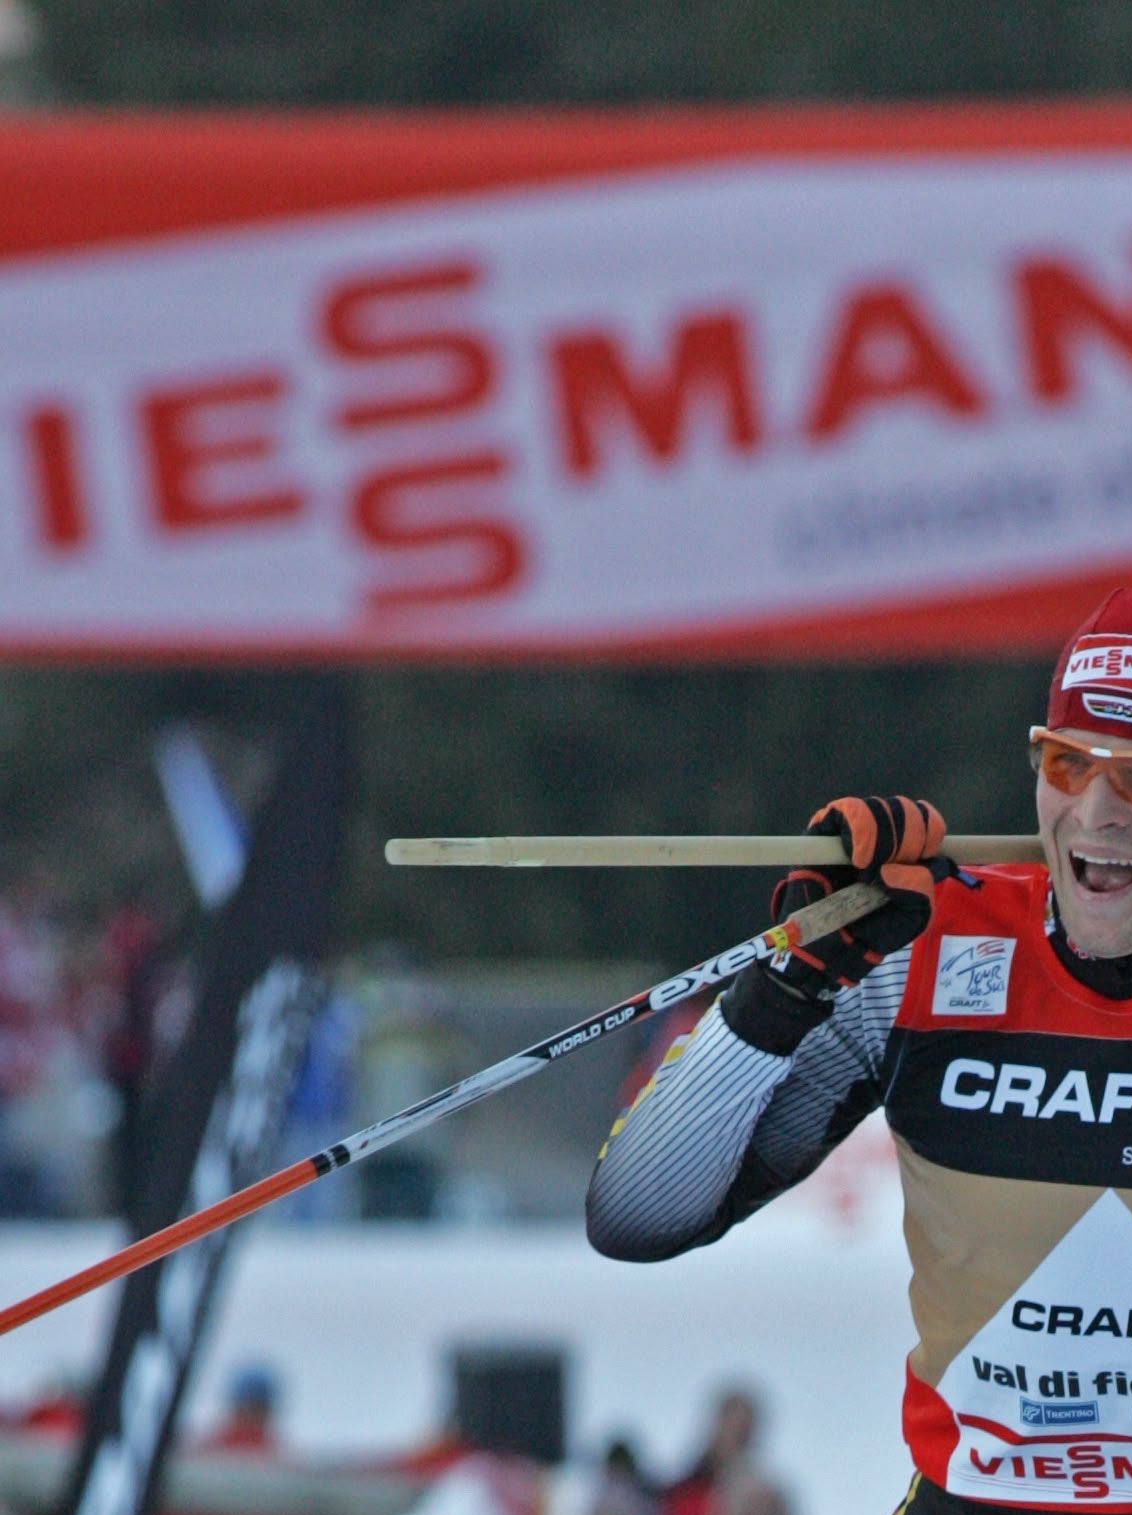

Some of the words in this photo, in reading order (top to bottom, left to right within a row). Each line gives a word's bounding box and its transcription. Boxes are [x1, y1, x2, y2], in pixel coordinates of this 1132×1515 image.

[549, 1024, 601, 1058] WORLD
[604, 1007, 636, 1031] CUP
[1038, 1370, 1081, 1398] di
